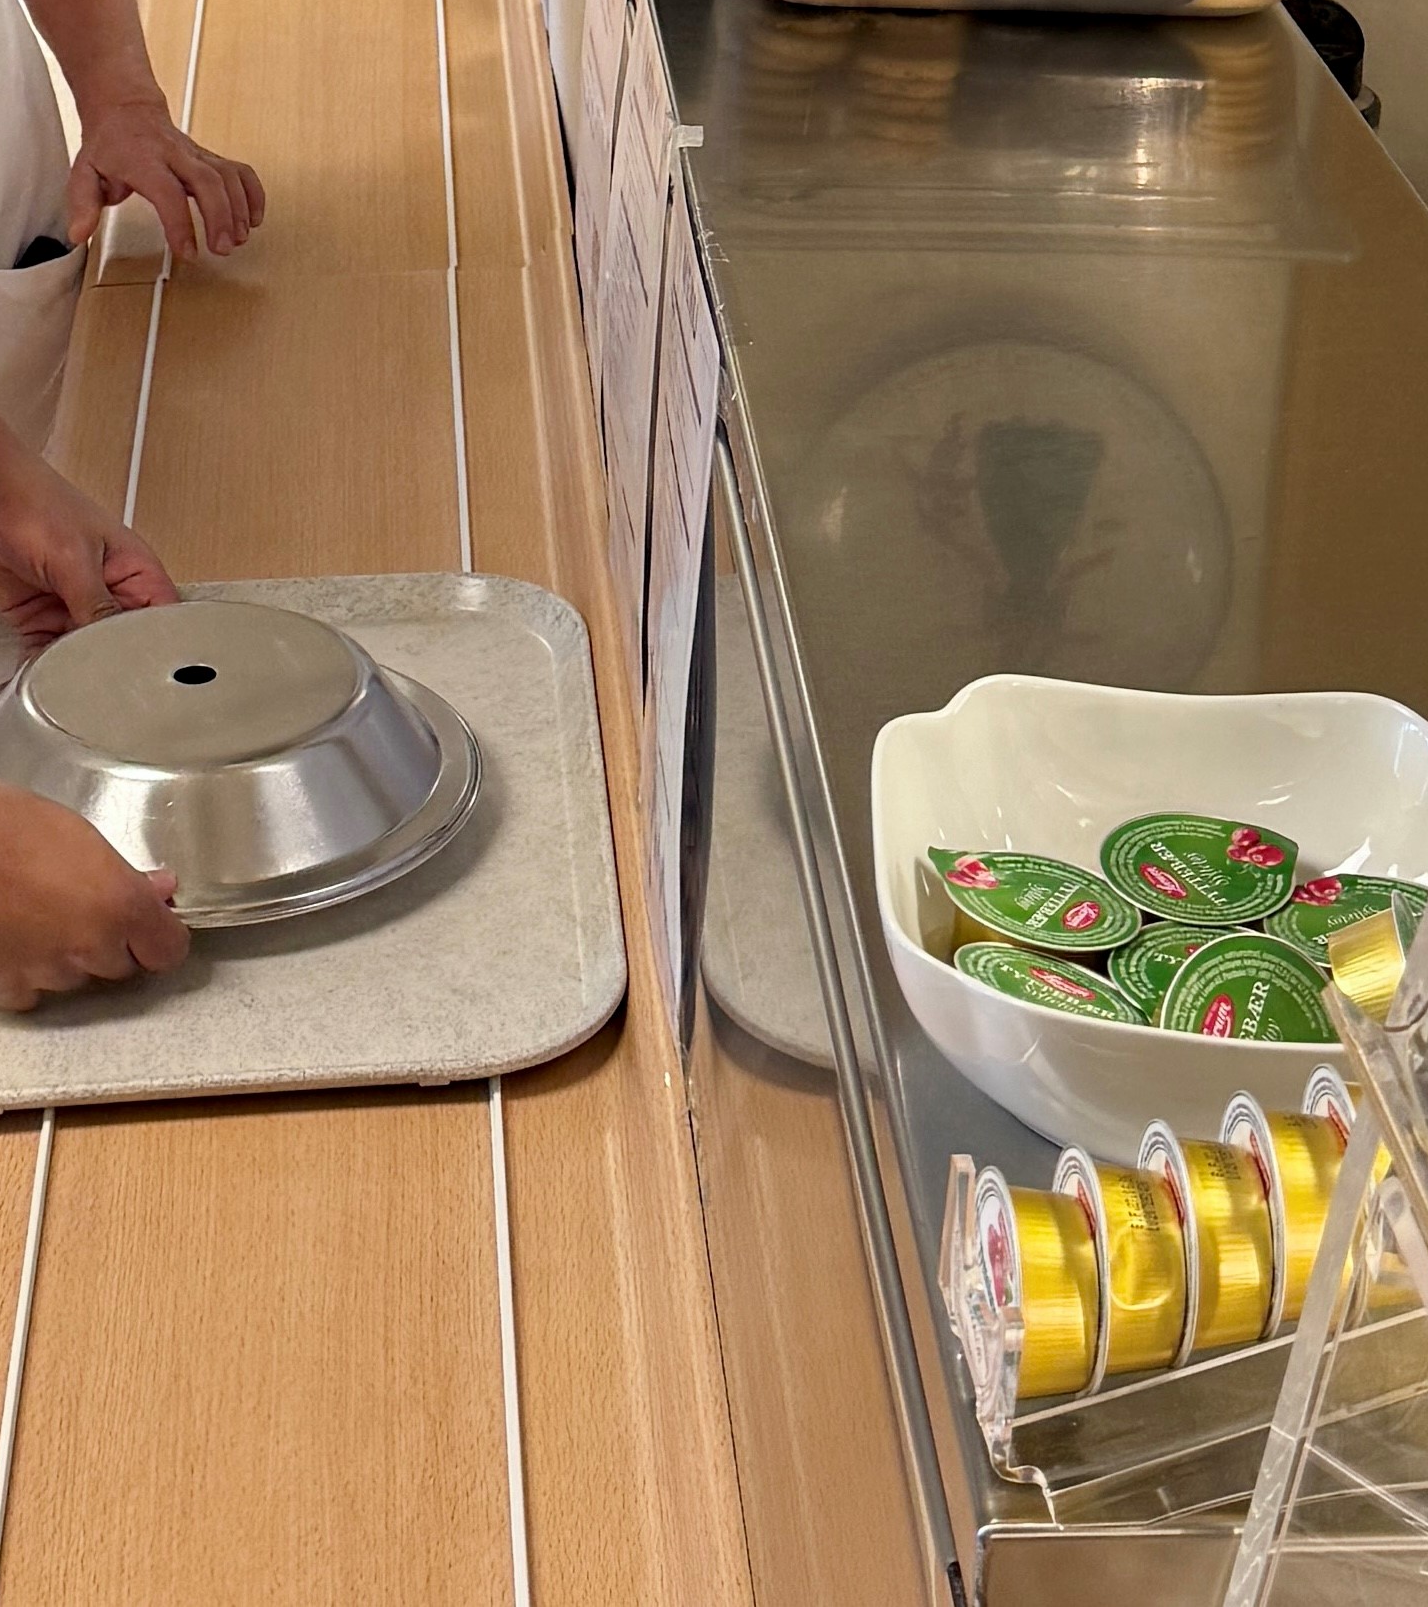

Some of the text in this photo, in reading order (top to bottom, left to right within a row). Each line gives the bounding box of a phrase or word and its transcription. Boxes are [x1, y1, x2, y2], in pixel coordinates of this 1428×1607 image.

[1150, 841, 1228, 907] TYTTEBÆR
[1024, 880, 1081, 931] TYTTEBÆR
[1238, 980, 1271, 1041] EBÆR
